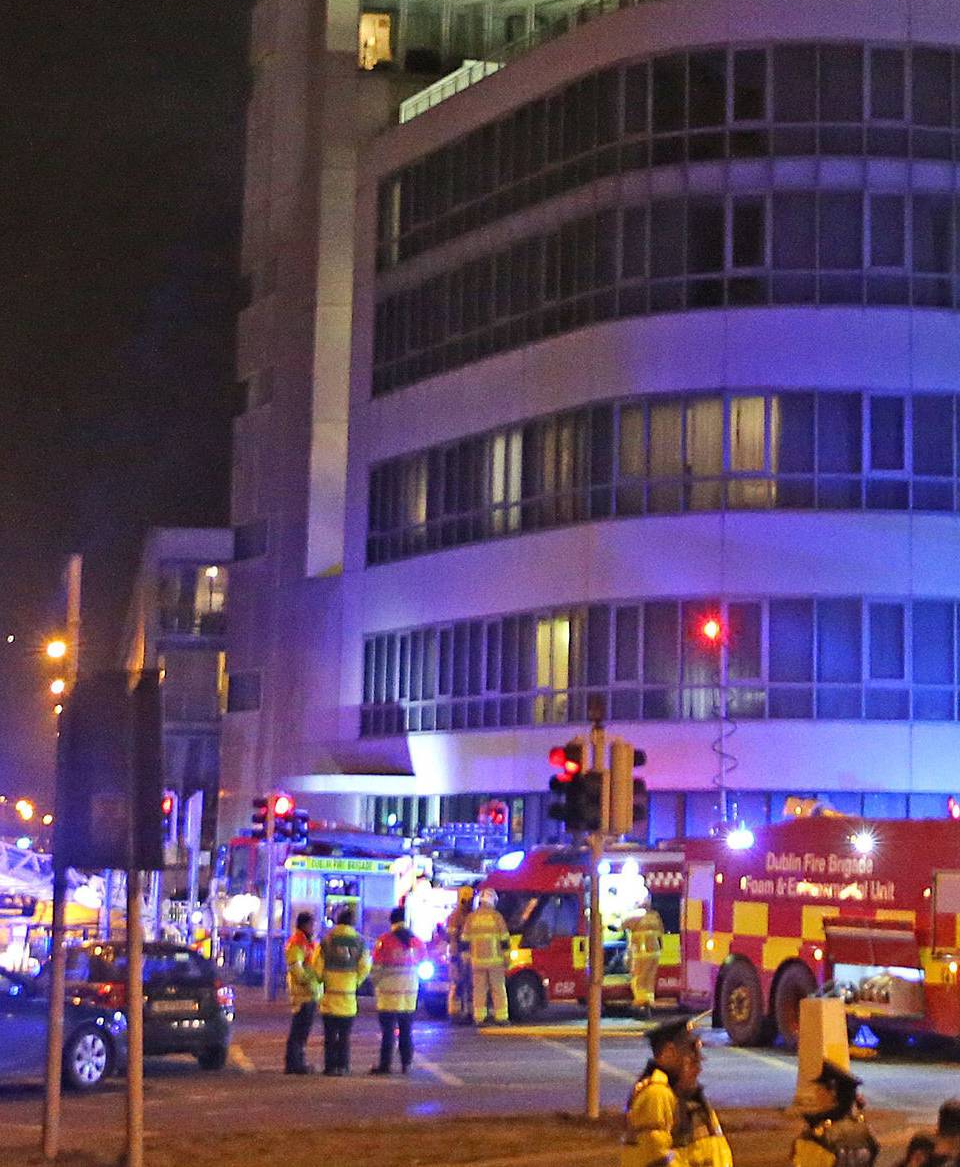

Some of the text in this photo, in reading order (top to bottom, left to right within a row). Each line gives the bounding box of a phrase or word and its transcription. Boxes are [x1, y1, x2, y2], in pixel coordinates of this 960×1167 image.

[766, 851, 874, 878] Dublin Fire Brigade
[776, 877, 785, 896] &
